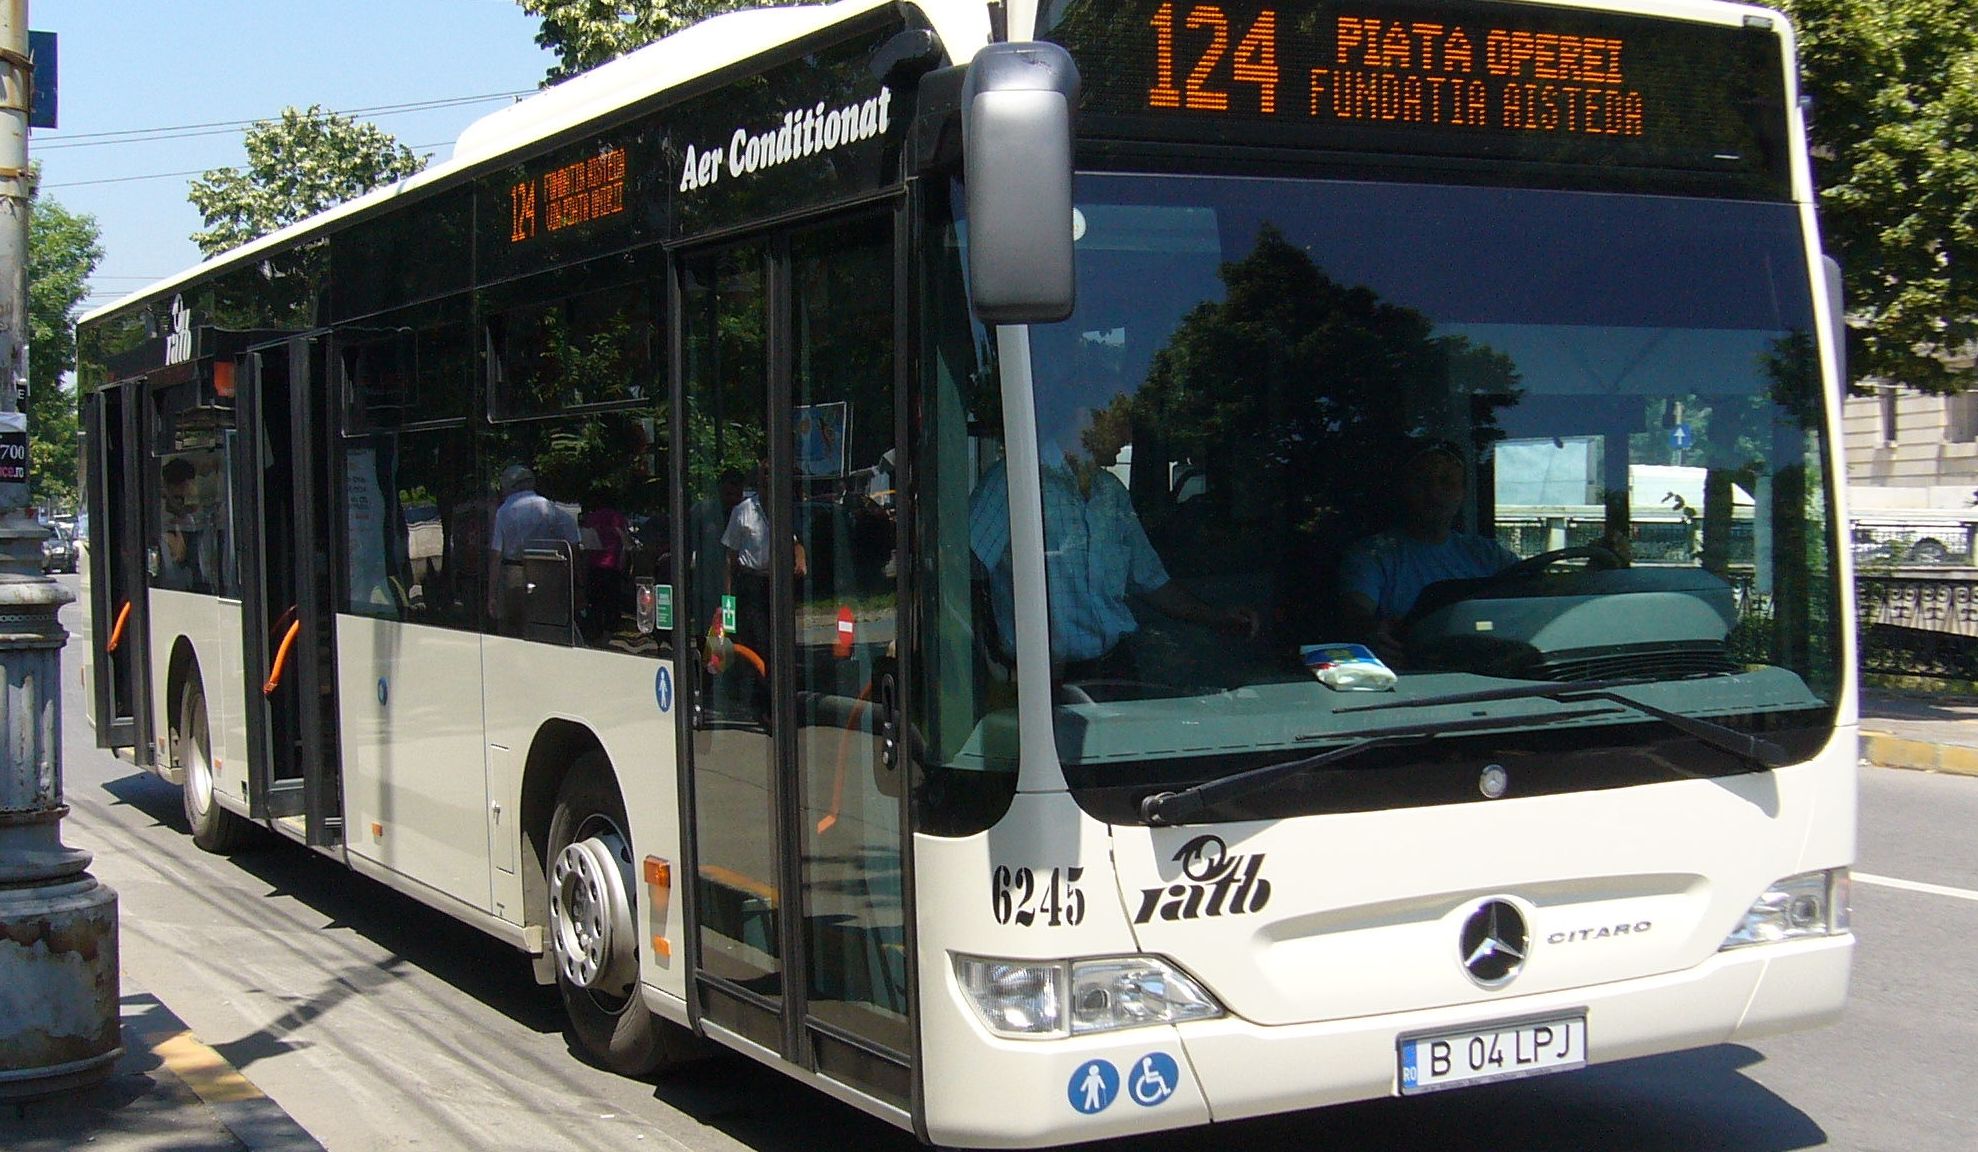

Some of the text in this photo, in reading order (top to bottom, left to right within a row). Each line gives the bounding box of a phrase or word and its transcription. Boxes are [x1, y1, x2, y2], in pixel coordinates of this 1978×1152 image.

[1149, 2, 1279, 113] 124
[1337, 16, 1623, 84] PIATA OPEREI
[1310, 68, 1643, 136] FUNDATIA AISTEDA
[679, 84, 892, 193] Aer Conditionat
[511, 178, 536, 243] 124
[992, 864, 1086, 927] 6245
[1547, 920, 1653, 945] CITARO
[1403, 1066, 1417, 1081] RO
[1430, 1023, 1571, 1078] B 04 LPJ
